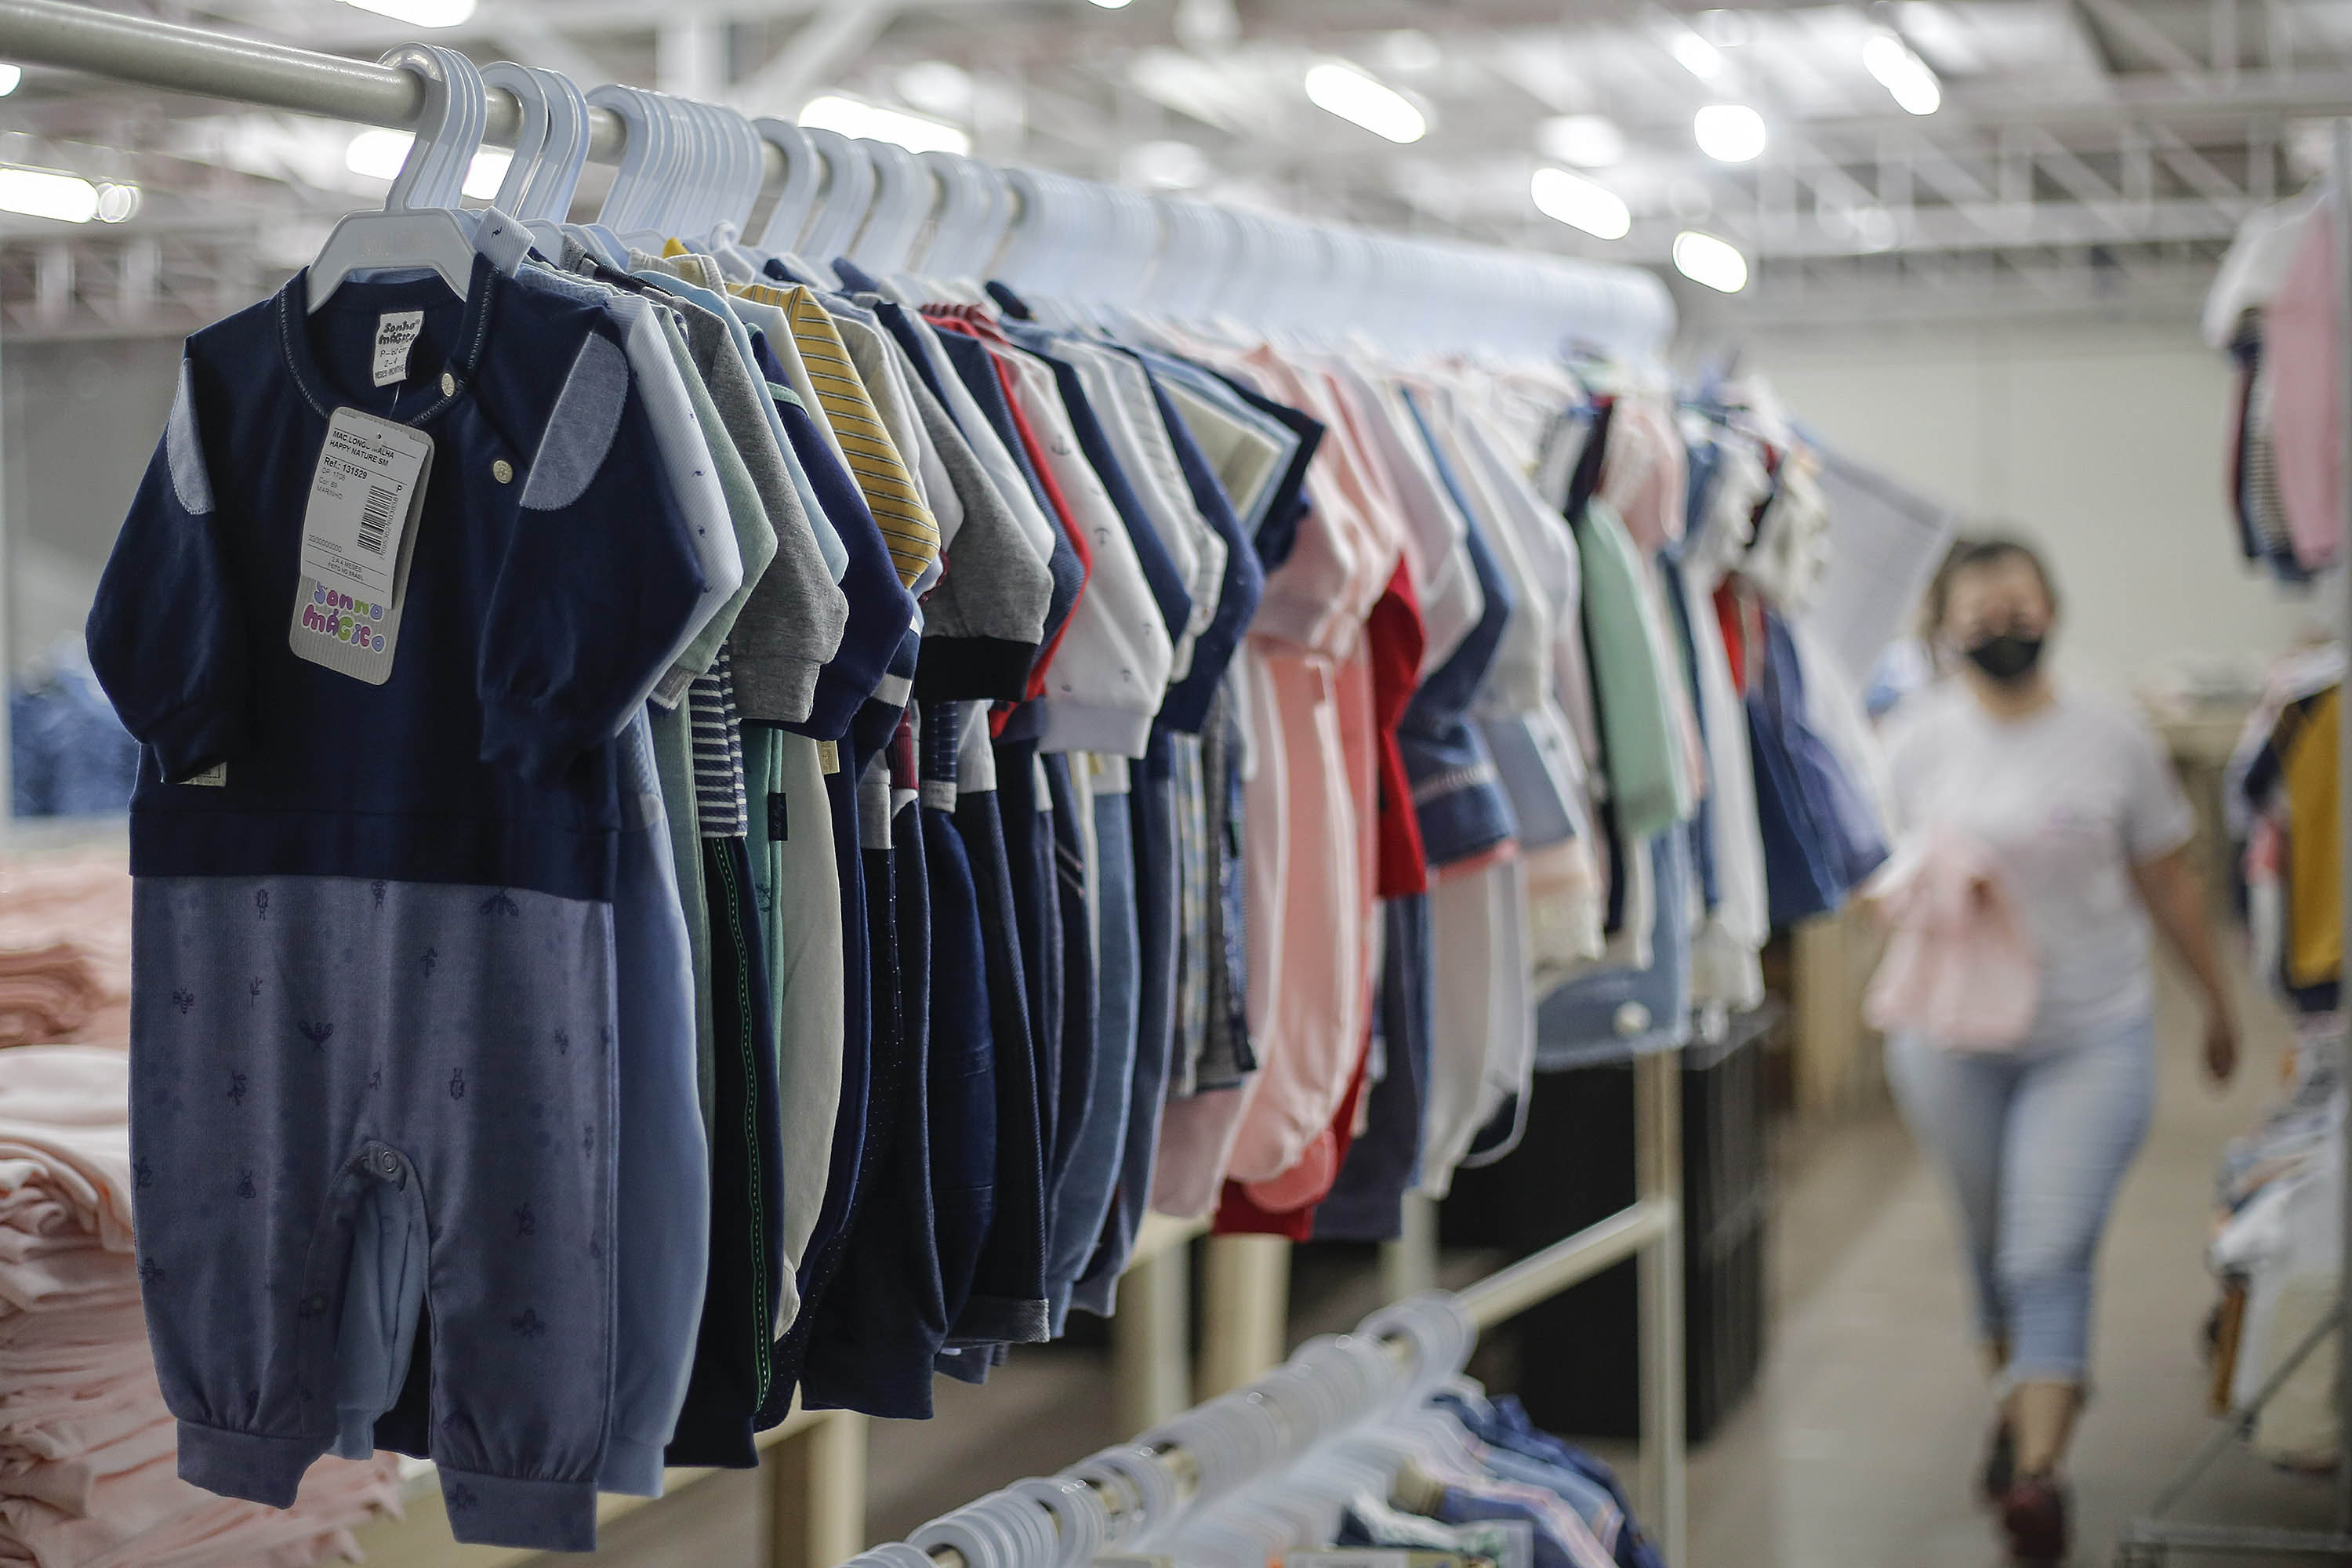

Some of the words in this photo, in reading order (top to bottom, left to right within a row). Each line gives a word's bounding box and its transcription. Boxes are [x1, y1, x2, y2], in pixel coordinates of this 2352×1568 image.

[383, 321, 416, 333] Sonho
[329, 440, 351, 452] HAPPY
[351, 448, 378, 463] NATURE
[378, 458, 389, 467] SM
[324, 456, 341, 470] Ref.:
[343, 464, 368, 480] 131529
[317, 485, 343, 499] MARINHO
[396, 485, 402, 493] P
[343, 561, 362, 572] MESES
